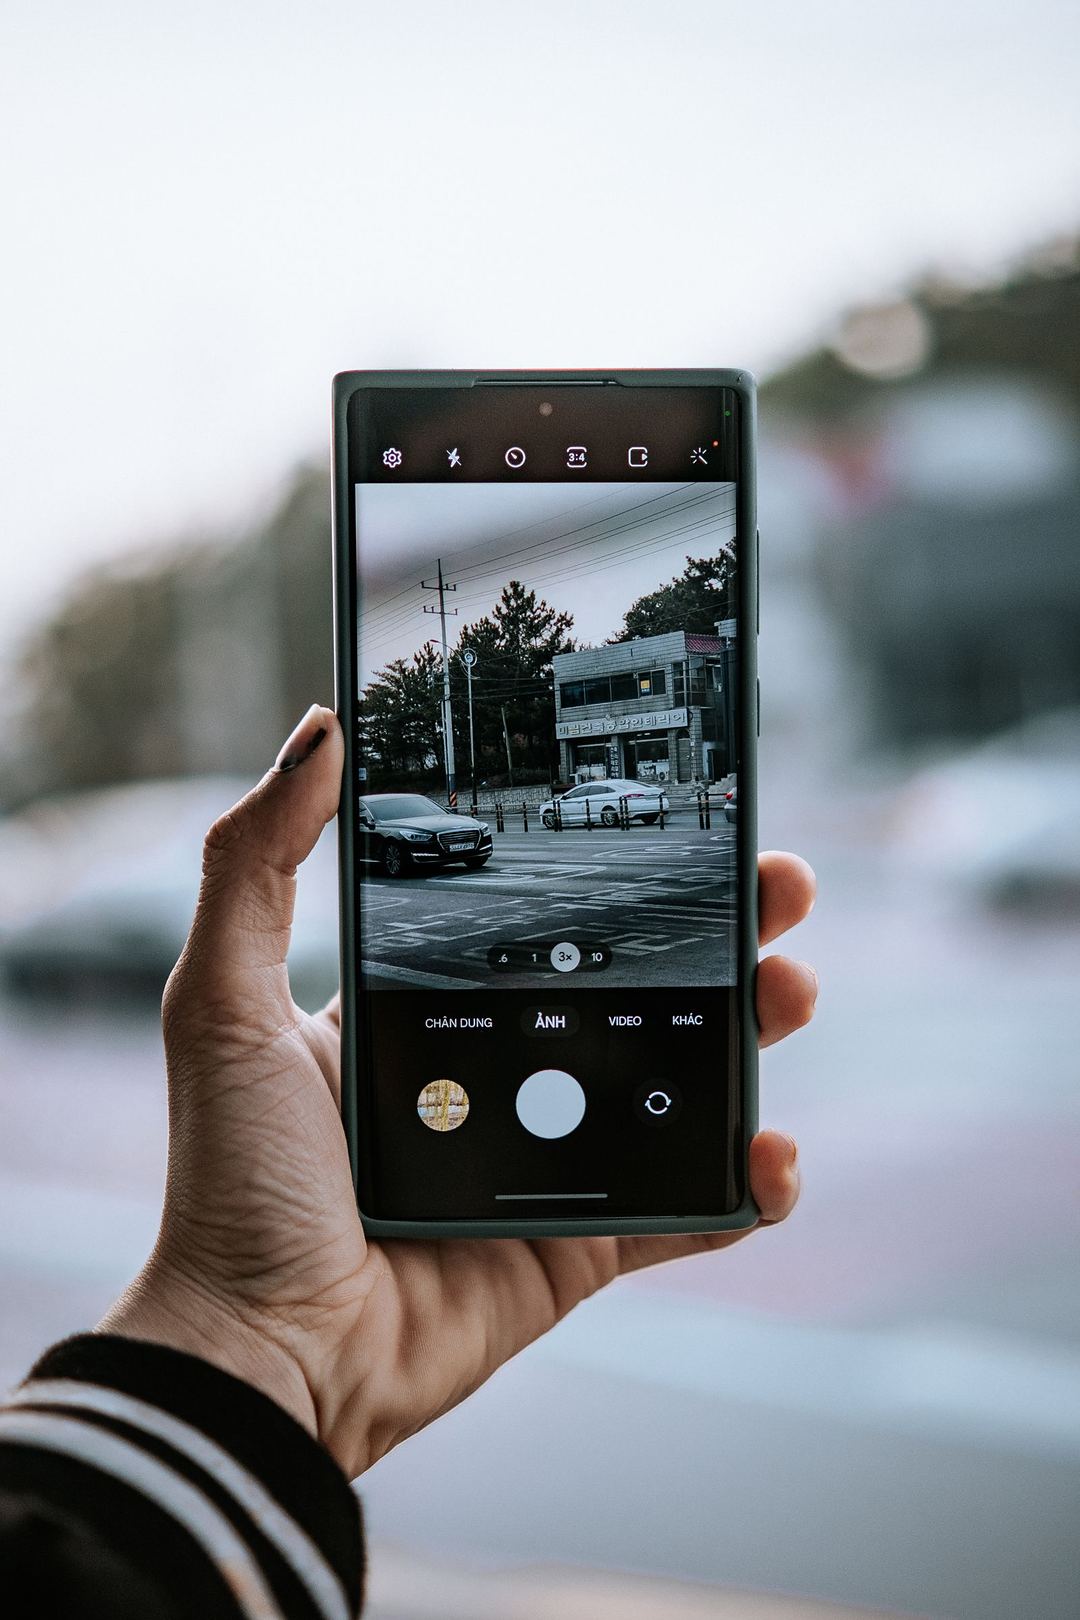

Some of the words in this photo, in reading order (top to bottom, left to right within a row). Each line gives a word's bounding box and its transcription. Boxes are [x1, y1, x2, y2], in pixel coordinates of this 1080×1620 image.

[568, 452, 586, 462] 3:4
[498, 953, 508, 963] .6
[531, 953, 537, 963] 1
[591, 952, 603, 962] 10
[425, 1016, 458, 1029] CHÂN
[460, 1017, 493, 1029] DUNG
[535, 1012, 566, 1029] ẢNH
[608, 1015, 642, 1026] VIDEO
[672, 1012, 703, 1026] KHÁC
